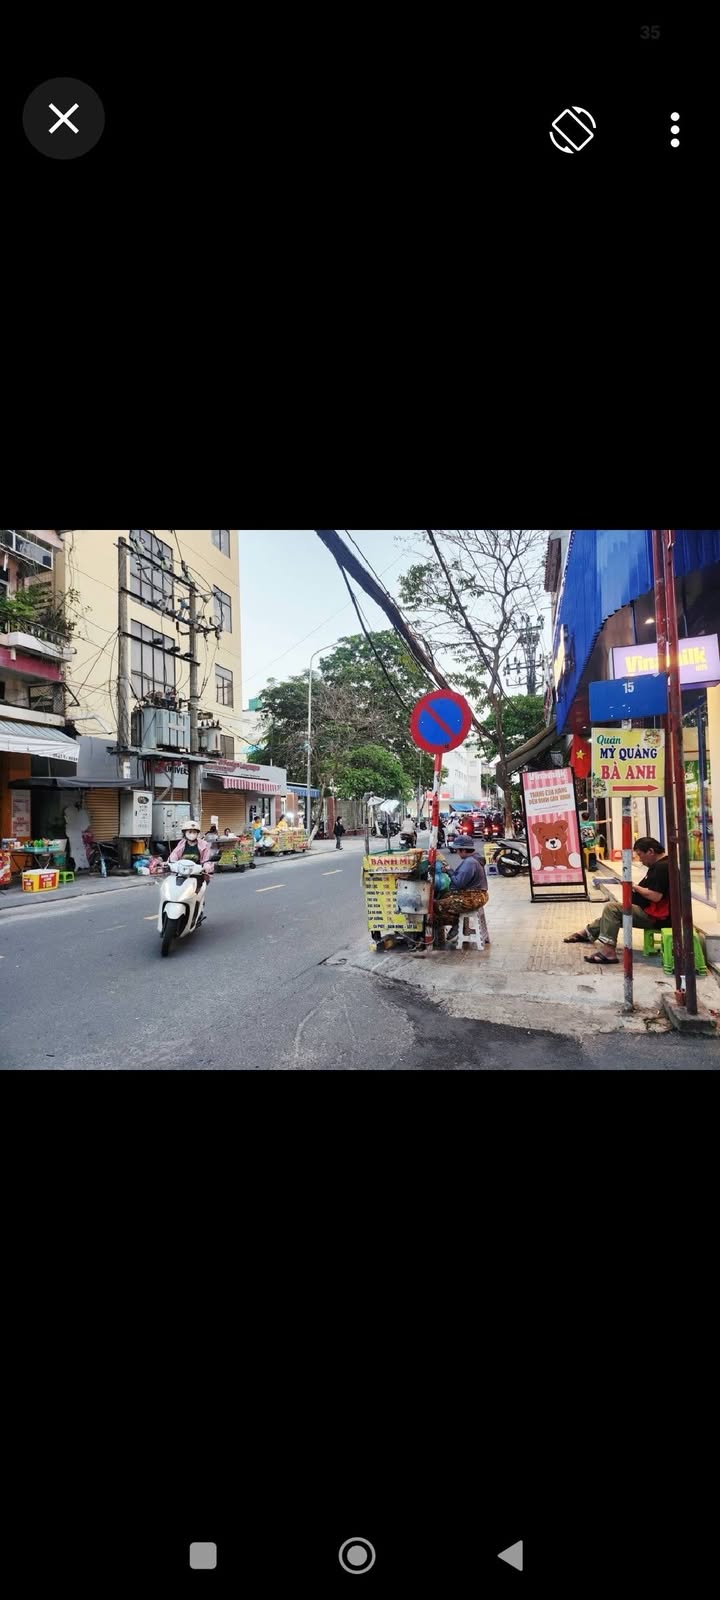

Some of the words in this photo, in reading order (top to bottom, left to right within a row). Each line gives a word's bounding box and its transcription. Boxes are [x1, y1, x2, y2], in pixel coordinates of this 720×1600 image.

[622, 682, 634, 694] 15
[619, 744, 658, 761] QUẢNG
[601, 761, 621, 780] BÀ
[625, 765, 656, 780] ANH
[370, 855, 398, 865] BÁNH
